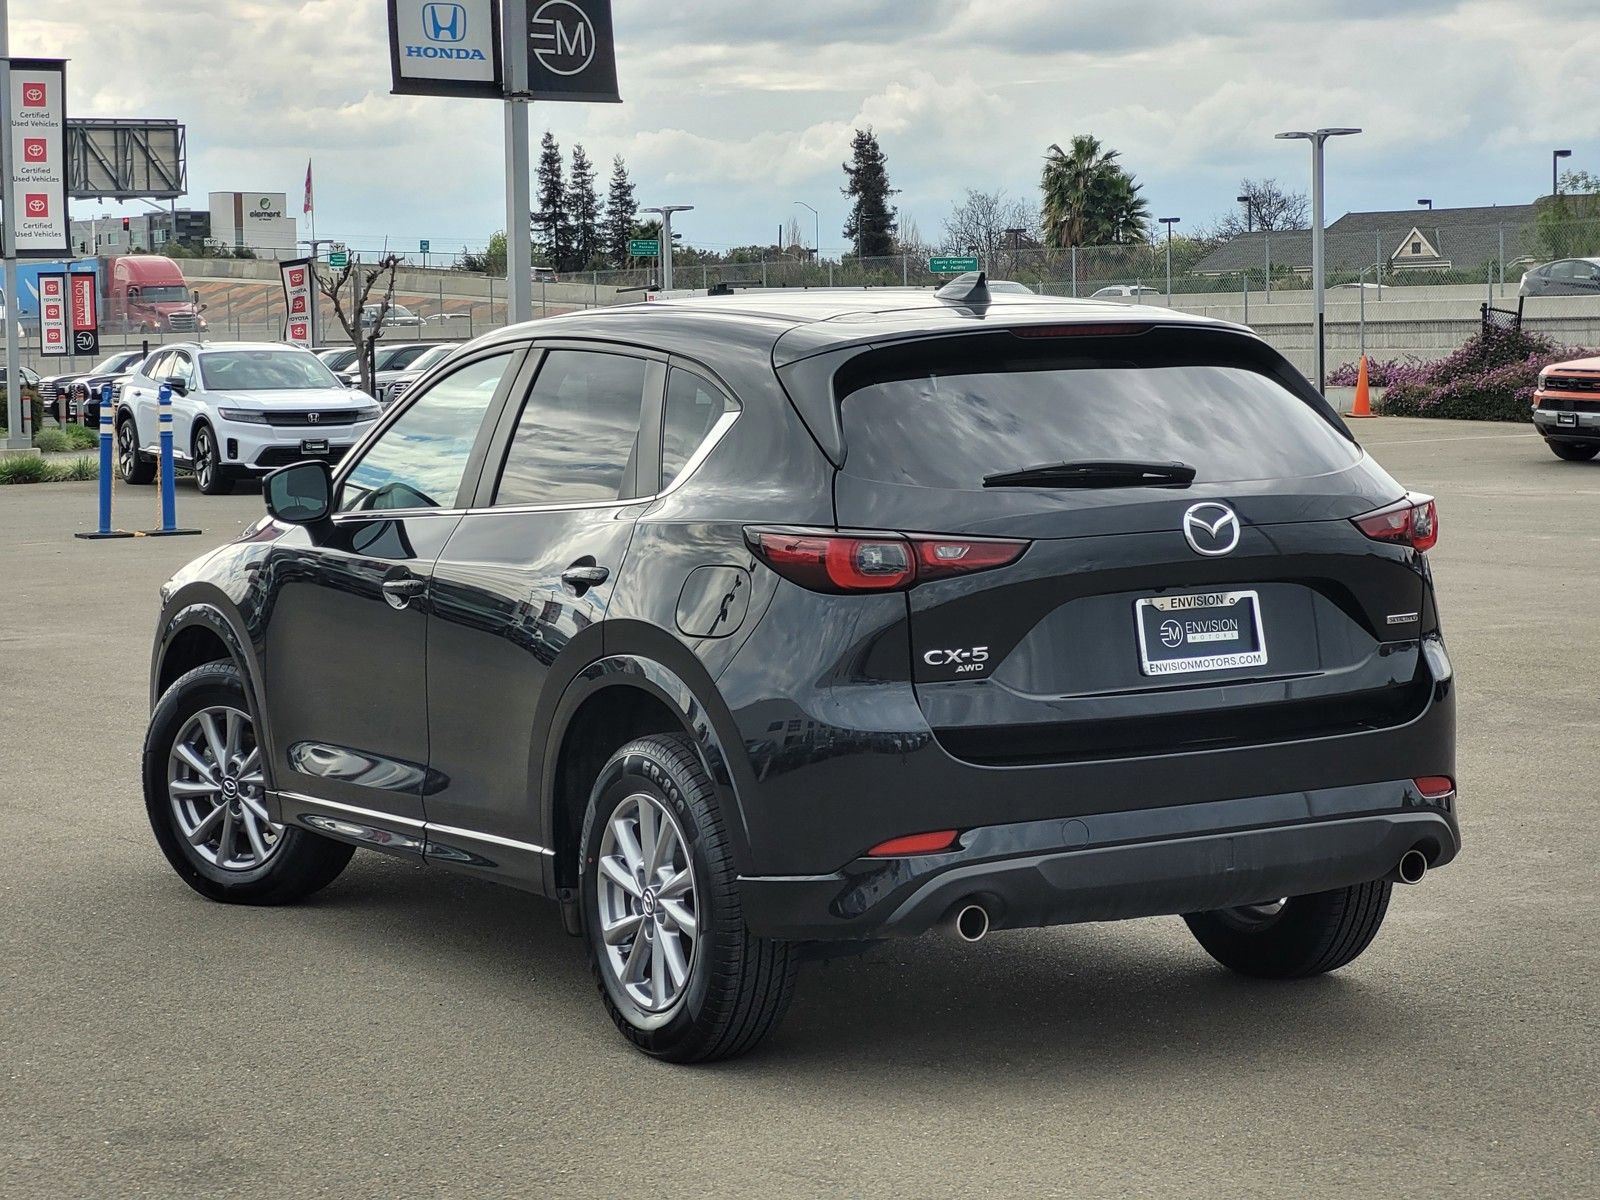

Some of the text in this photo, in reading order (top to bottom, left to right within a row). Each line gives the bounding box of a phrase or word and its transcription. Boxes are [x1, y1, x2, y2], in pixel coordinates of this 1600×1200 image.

[405, 46, 487, 61] HONDA
[20, 111, 50, 119] Certified
[249, 210, 282, 218] element
[75, 280, 85, 326] ENVISION
[1170, 594, 1224, 609] ENVISION
[1185, 618, 1239, 633] ENVISION
[923, 646, 989, 666] CX-5
[1149, 654, 1262, 673] ENVISIONMOTORS.COM
[955, 663, 984, 674] AWD
